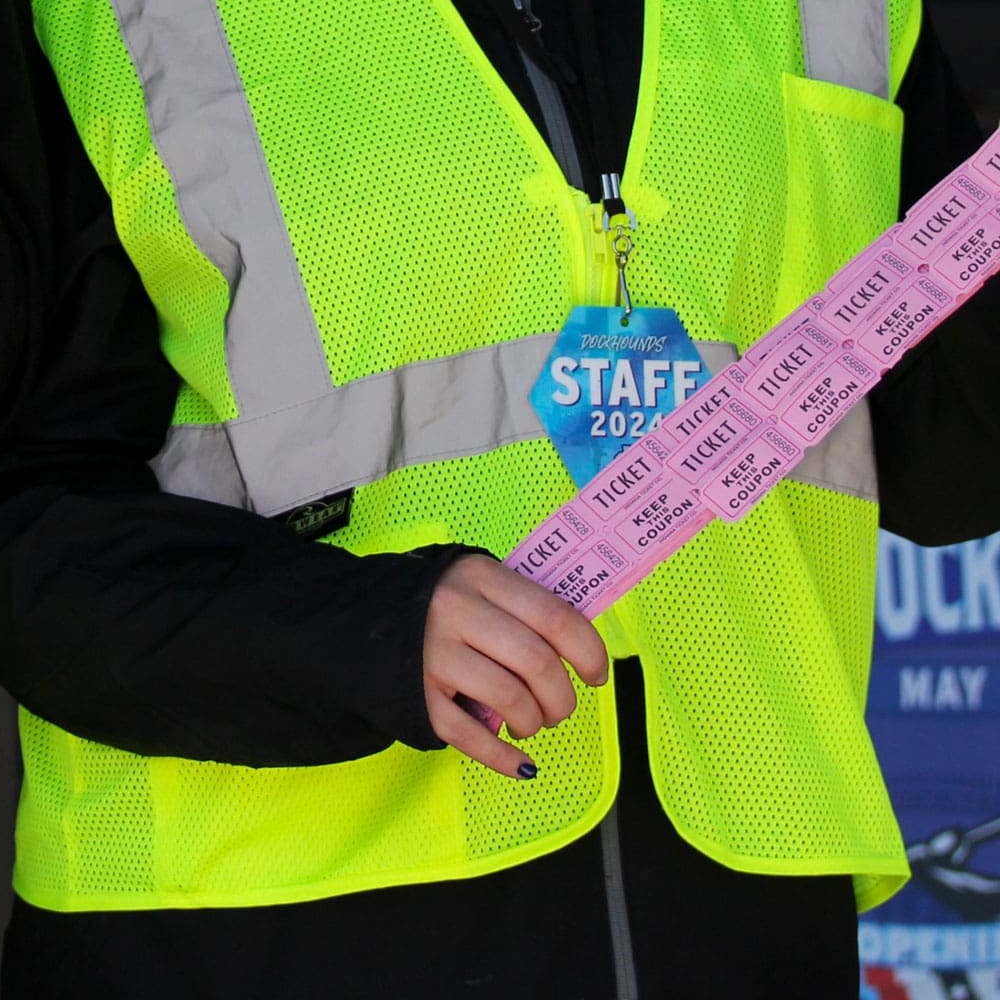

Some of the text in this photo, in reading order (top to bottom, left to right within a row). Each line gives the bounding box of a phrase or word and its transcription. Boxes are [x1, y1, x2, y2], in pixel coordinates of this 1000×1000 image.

[911, 196, 966, 246] TICKET
[952, 229, 984, 261] KEEP
[967, 241, 987, 259] THIS
[835, 271, 889, 322] TICKET
[876, 302, 907, 335] KEEP
[883, 305, 934, 355] COUPON
[890, 314, 910, 333] THIS
[581, 335, 667, 353] DOCKHOUNDS
[551, 356, 702, 407] STAFF
[758, 344, 813, 396] TICKET
[676, 387, 730, 435] TICKET
[799, 378, 831, 412] KEEP
[808, 381, 858, 433] COUPON
[814, 391, 834, 410] THIS
[681, 420, 736, 471] TICKET
[767, 432, 795, 456] 456680
[593, 457, 651, 508] TICKET
[722, 453, 754, 487] KEEP
[729, 458, 781, 508] COUPON
[736, 467, 757, 486] THIS
[563, 511, 589, 535] 456428
[633, 494, 667, 526] KEEP
[638, 499, 693, 546] COUPON
[647, 507, 669, 525] THIS
[597, 544, 624, 568] 456428
[563, 579, 585, 597] THIS
[900, 665, 988, 711] MAY
